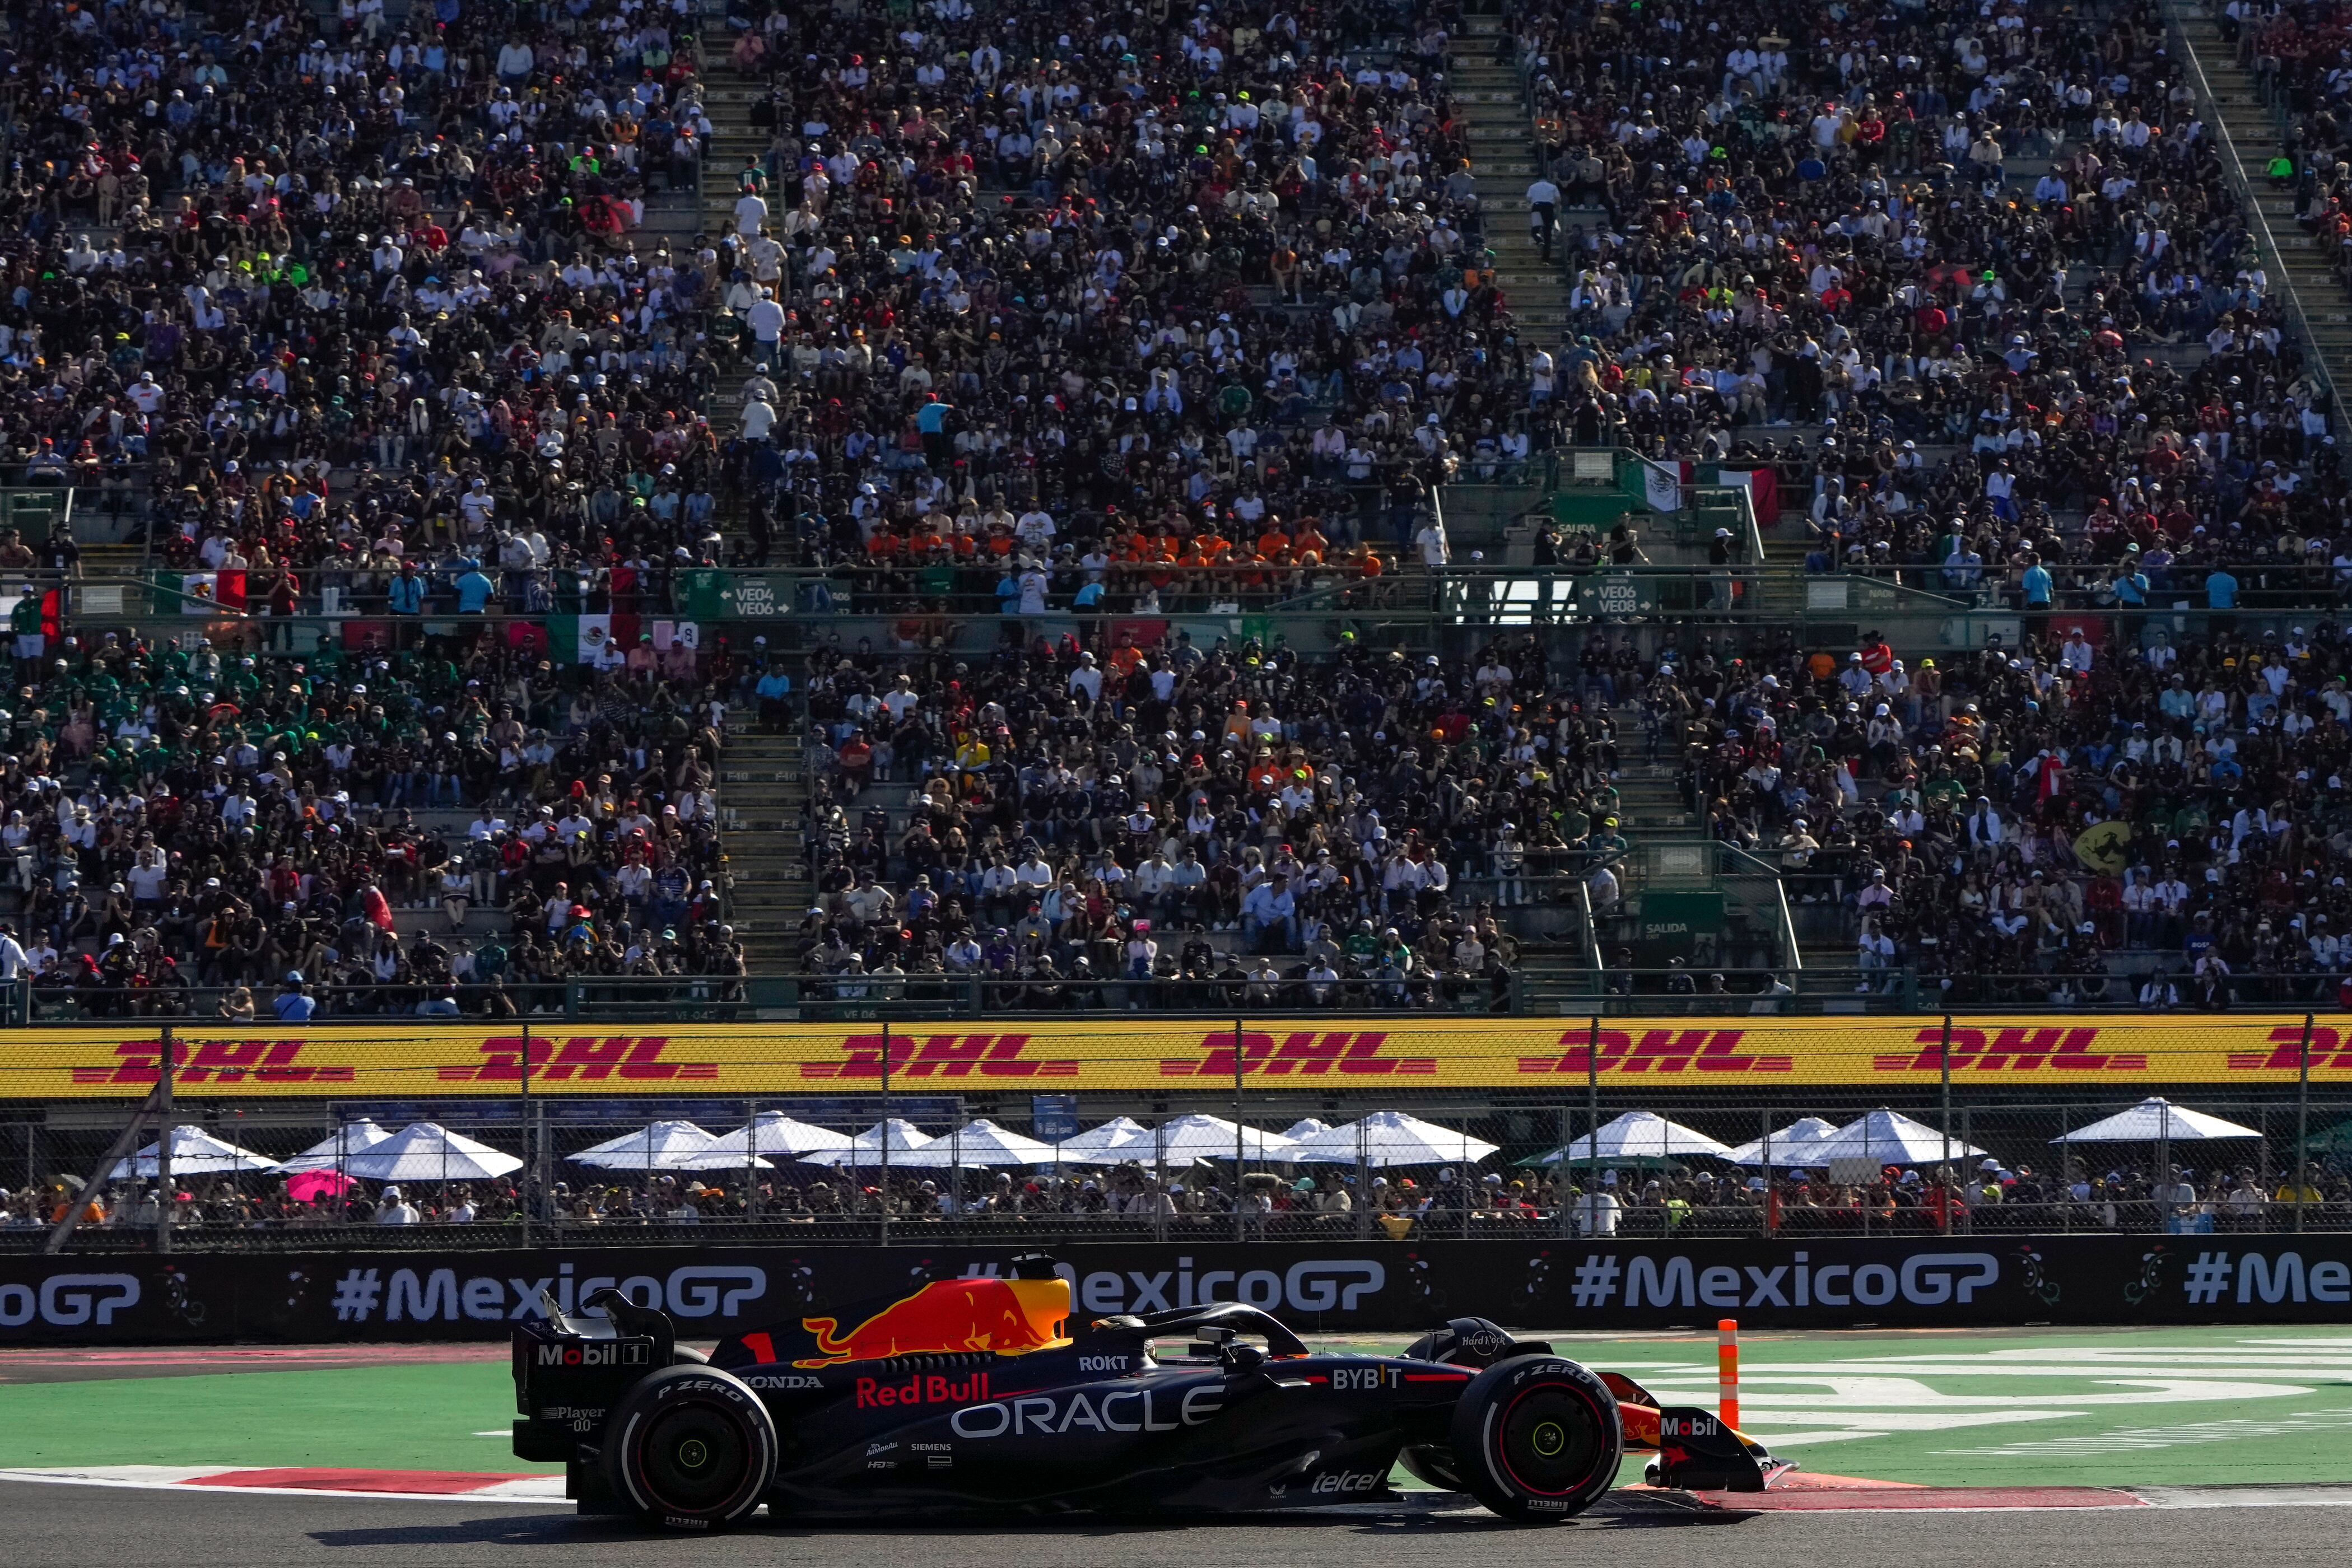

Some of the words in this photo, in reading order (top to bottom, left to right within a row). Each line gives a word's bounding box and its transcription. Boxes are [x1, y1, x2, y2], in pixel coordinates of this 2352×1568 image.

[735, 588, 774, 601] VE04
[1598, 586, 1637, 599] VE06
[736, 602, 774, 615] VE06
[1598, 600, 1637, 613] VE08
[1646, 923, 1687, 933] SALIDA
[111, 1039, 317, 1083] DHL
[476, 1037, 682, 1081] DHL
[840, 1034, 1044, 1077] DHL
[1199, 1032, 1399, 1075] DHL
[1555, 1030, 1754, 1072] DHL
[1911, 1028, 2109, 1070] DHL
[957, 1256, 1386, 1314] exicoGP
[1571, 1250, 1999, 1308] #MexicoGP
[740, 1333, 776, 1364] 1
[1462, 1336, 1483, 1346] Hard
[538, 1344, 617, 1366] Mobil
[1079, 1355, 1129, 1371] ROKT
[1334, 1363, 1401, 1389] BYBIT
[1514, 1371, 1526, 1385] P
[1531, 1364, 1592, 1390] ZERO
[658, 1385, 672, 1399] P
[677, 1380, 744, 1402] ZERO
[856, 1375, 920, 1408] Red
[927, 1373, 988, 1403] Bull
[557, 1406, 606, 1421] Player
[951, 1385, 1226, 1439] ORACLE
[1661, 1417, 1717, 1436] Mobil
[1311, 1469, 1385, 1494] telcel
[1527, 1500, 1568, 1512] PIRELLI
[665, 1515, 709, 1529] PIRELLI
